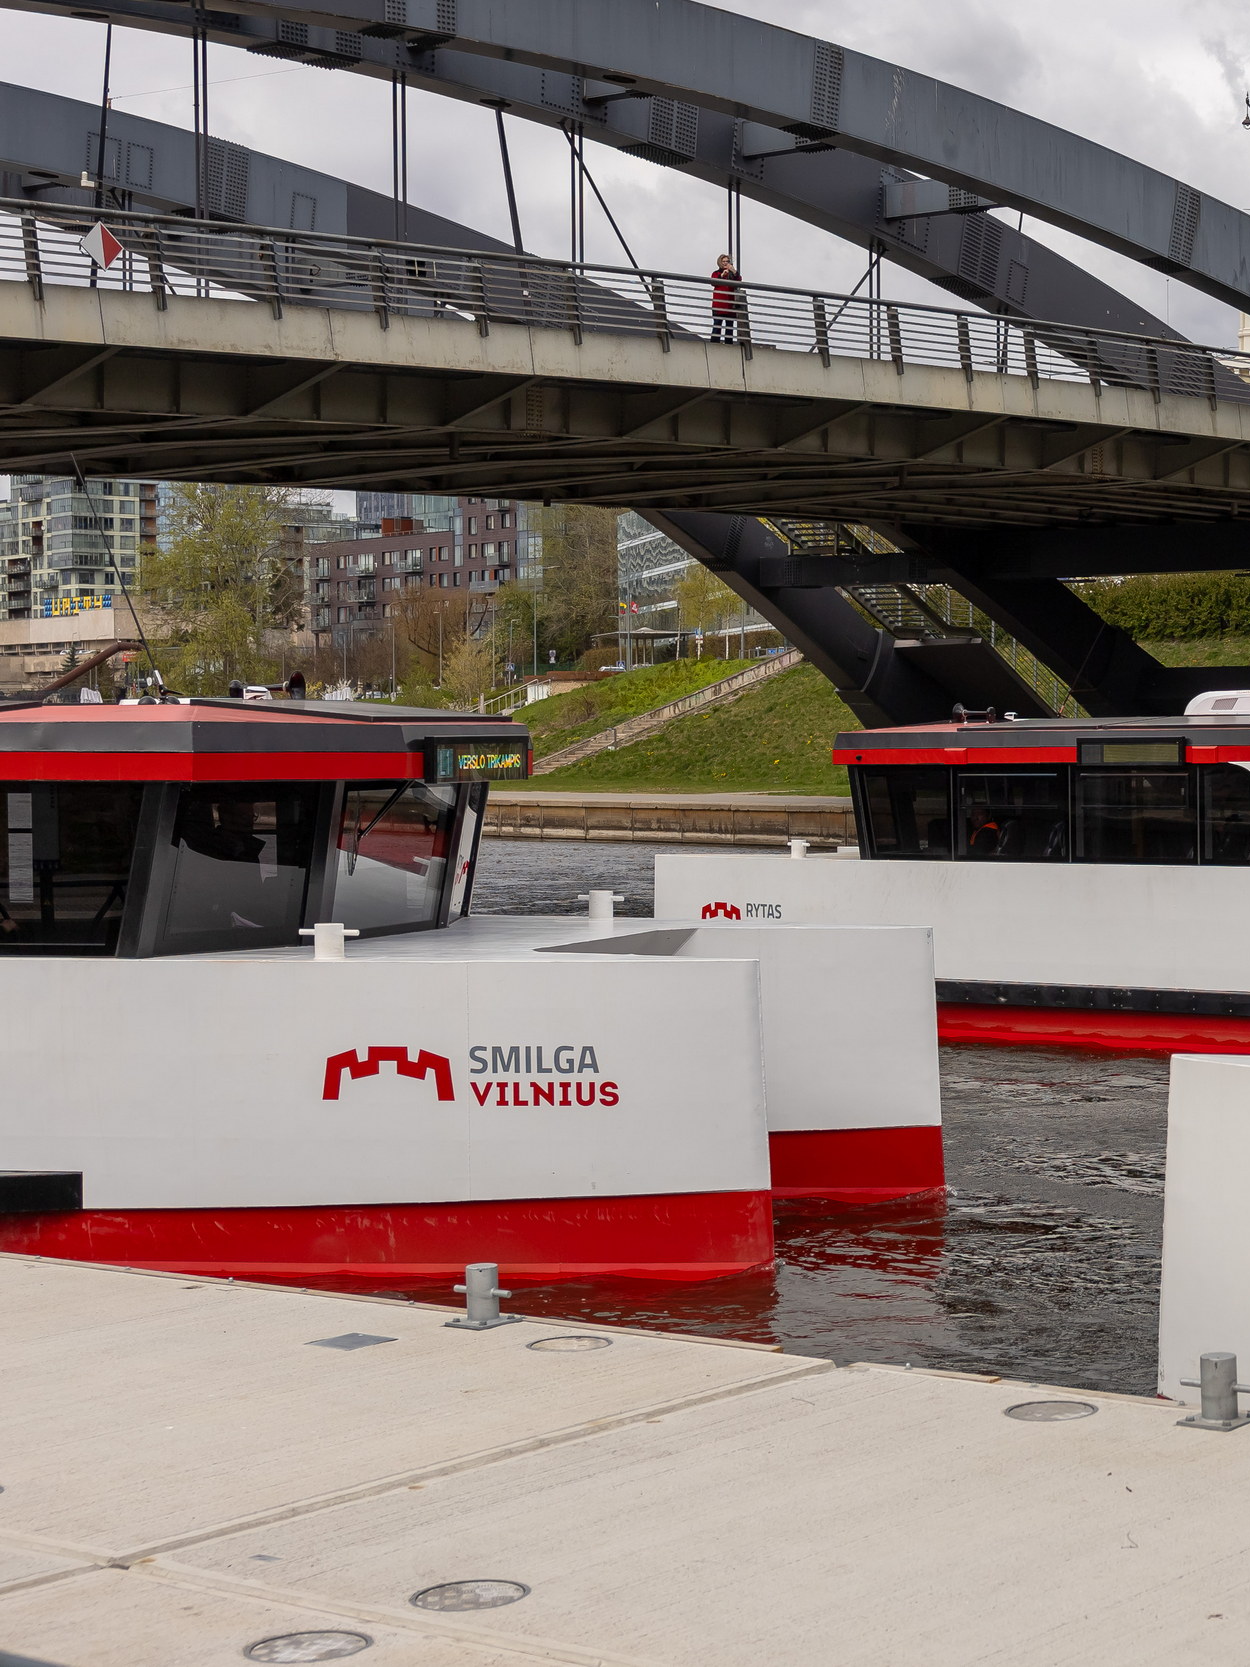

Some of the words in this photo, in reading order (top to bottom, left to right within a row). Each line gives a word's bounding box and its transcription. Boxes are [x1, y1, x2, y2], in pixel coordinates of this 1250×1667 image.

[458, 754, 486, 769] VERSLO
[487, 753, 521, 769] TRIKAMPIS
[745, 903, 782, 919] RYTAS
[469, 1045, 600, 1074] SMILGA
[470, 1081, 620, 1107] VILNIUS
